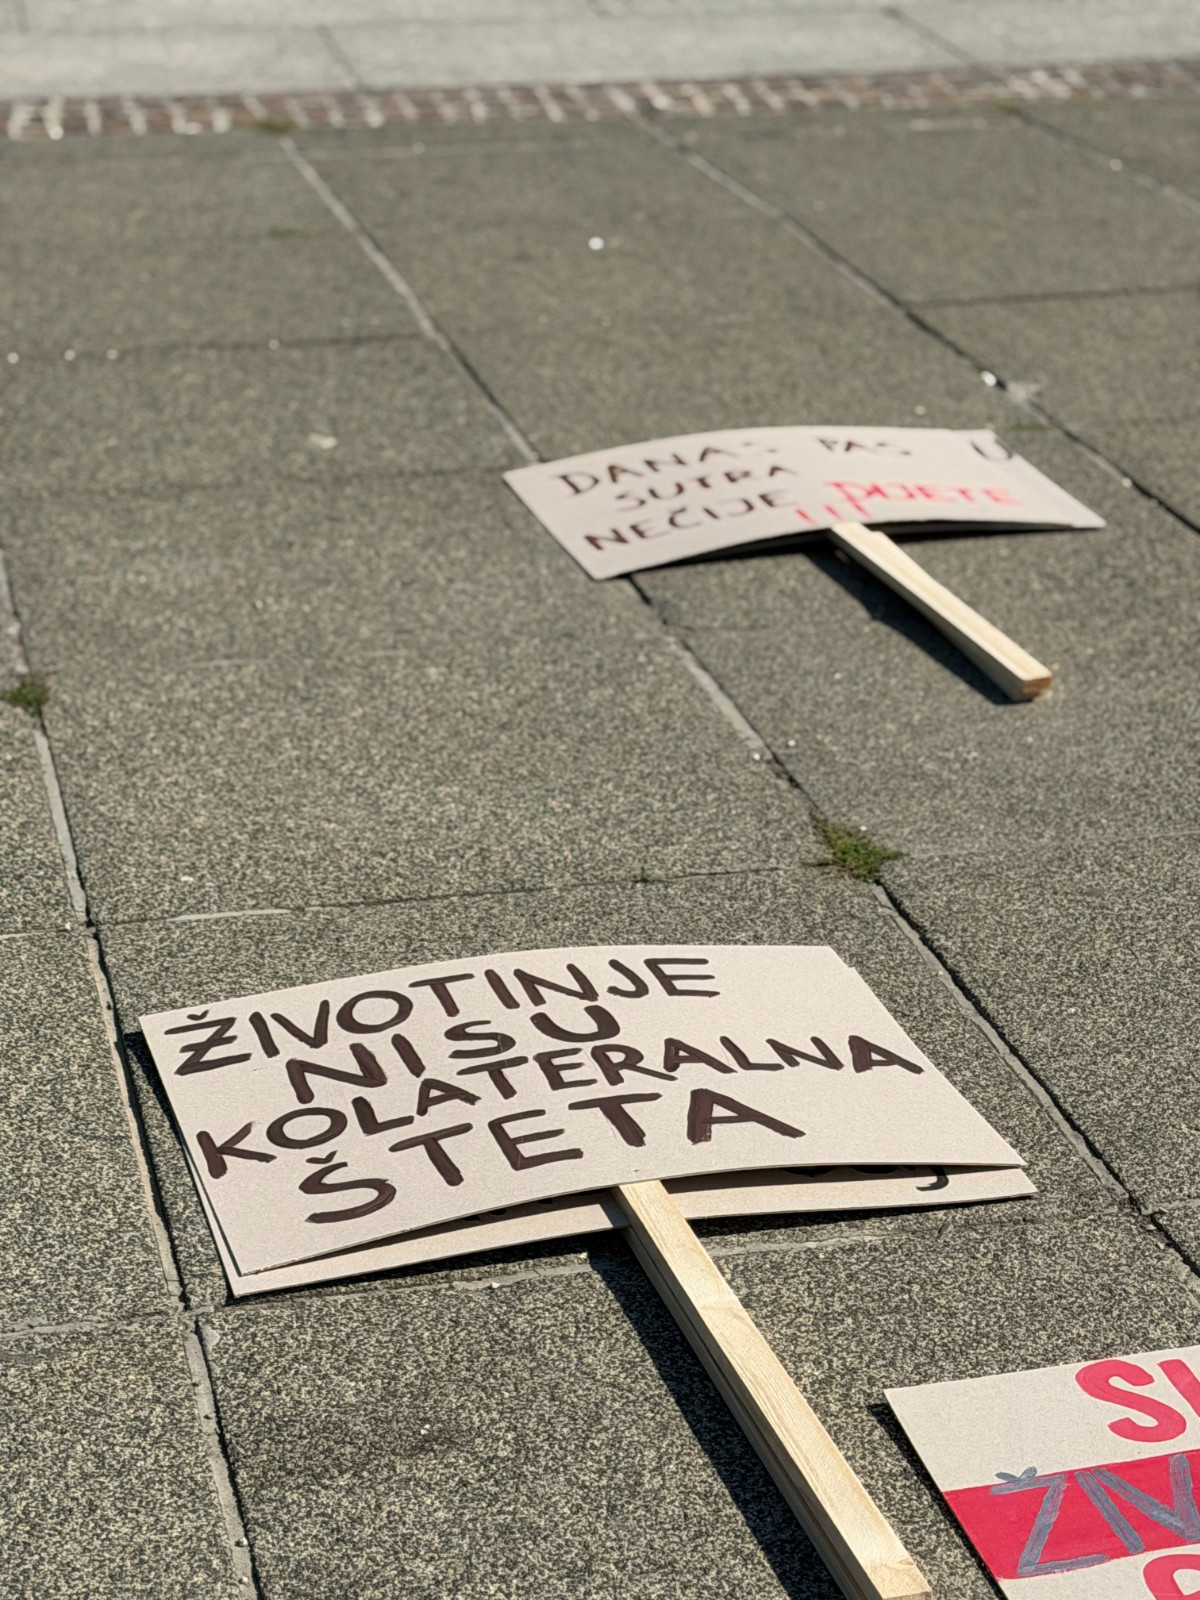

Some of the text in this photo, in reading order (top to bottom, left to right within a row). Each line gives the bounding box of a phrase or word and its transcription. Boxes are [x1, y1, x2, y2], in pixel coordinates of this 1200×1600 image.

[556, 438, 778, 496] DANAS
[615, 464, 797, 512] SUTRA
[163, 957, 720, 1076] ŽIVOTINJE
[285, 1004, 620, 1104] NISU
[196, 1034, 924, 1179] KOLATERALNA
[298, 1087, 806, 1224] ŠTETA
